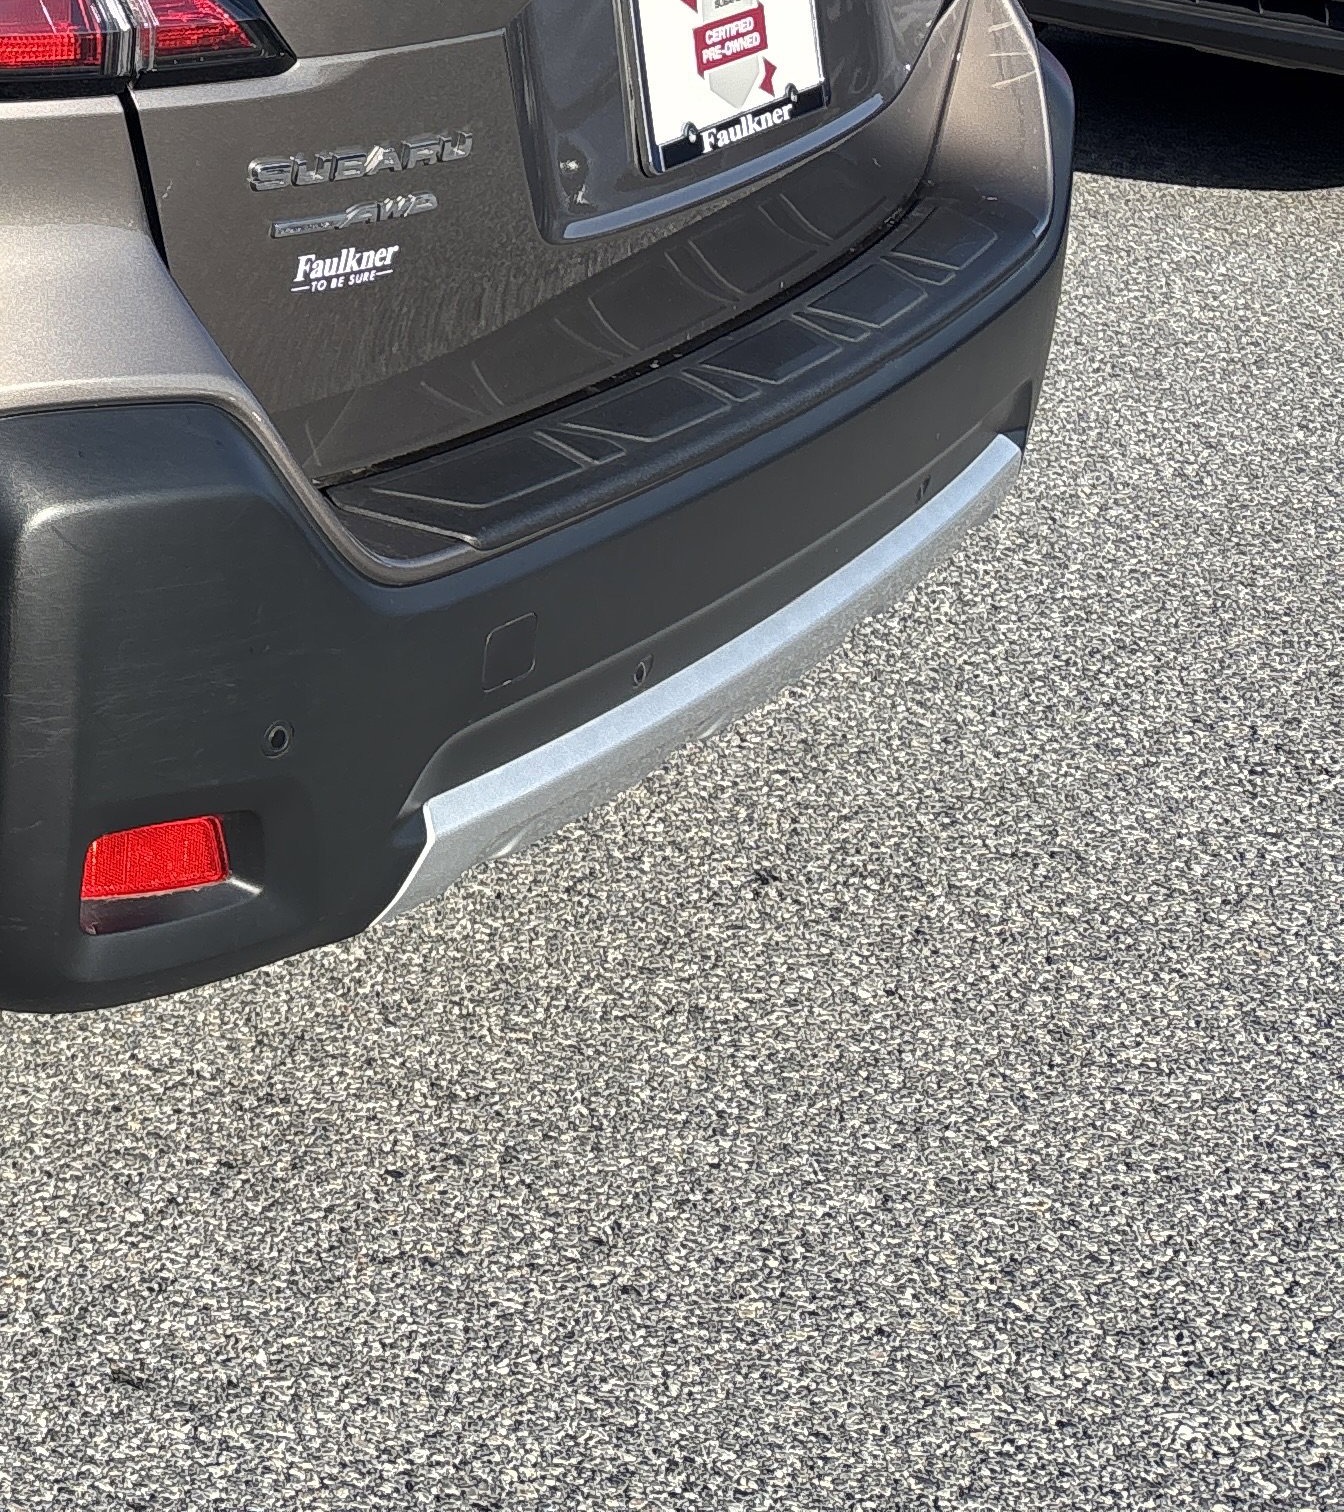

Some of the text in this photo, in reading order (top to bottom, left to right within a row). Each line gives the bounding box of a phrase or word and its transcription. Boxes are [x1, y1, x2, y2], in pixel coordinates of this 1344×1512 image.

[702, 31, 761, 64] PRE-OWNED
[705, 16, 755, 45] CERTIFIED
[701, 103, 793, 153] Faulkner
[247, 130, 473, 192] SUBARU
[293, 245, 399, 282] Faulkner
[311, 269, 377, 292] TO BE SURE
